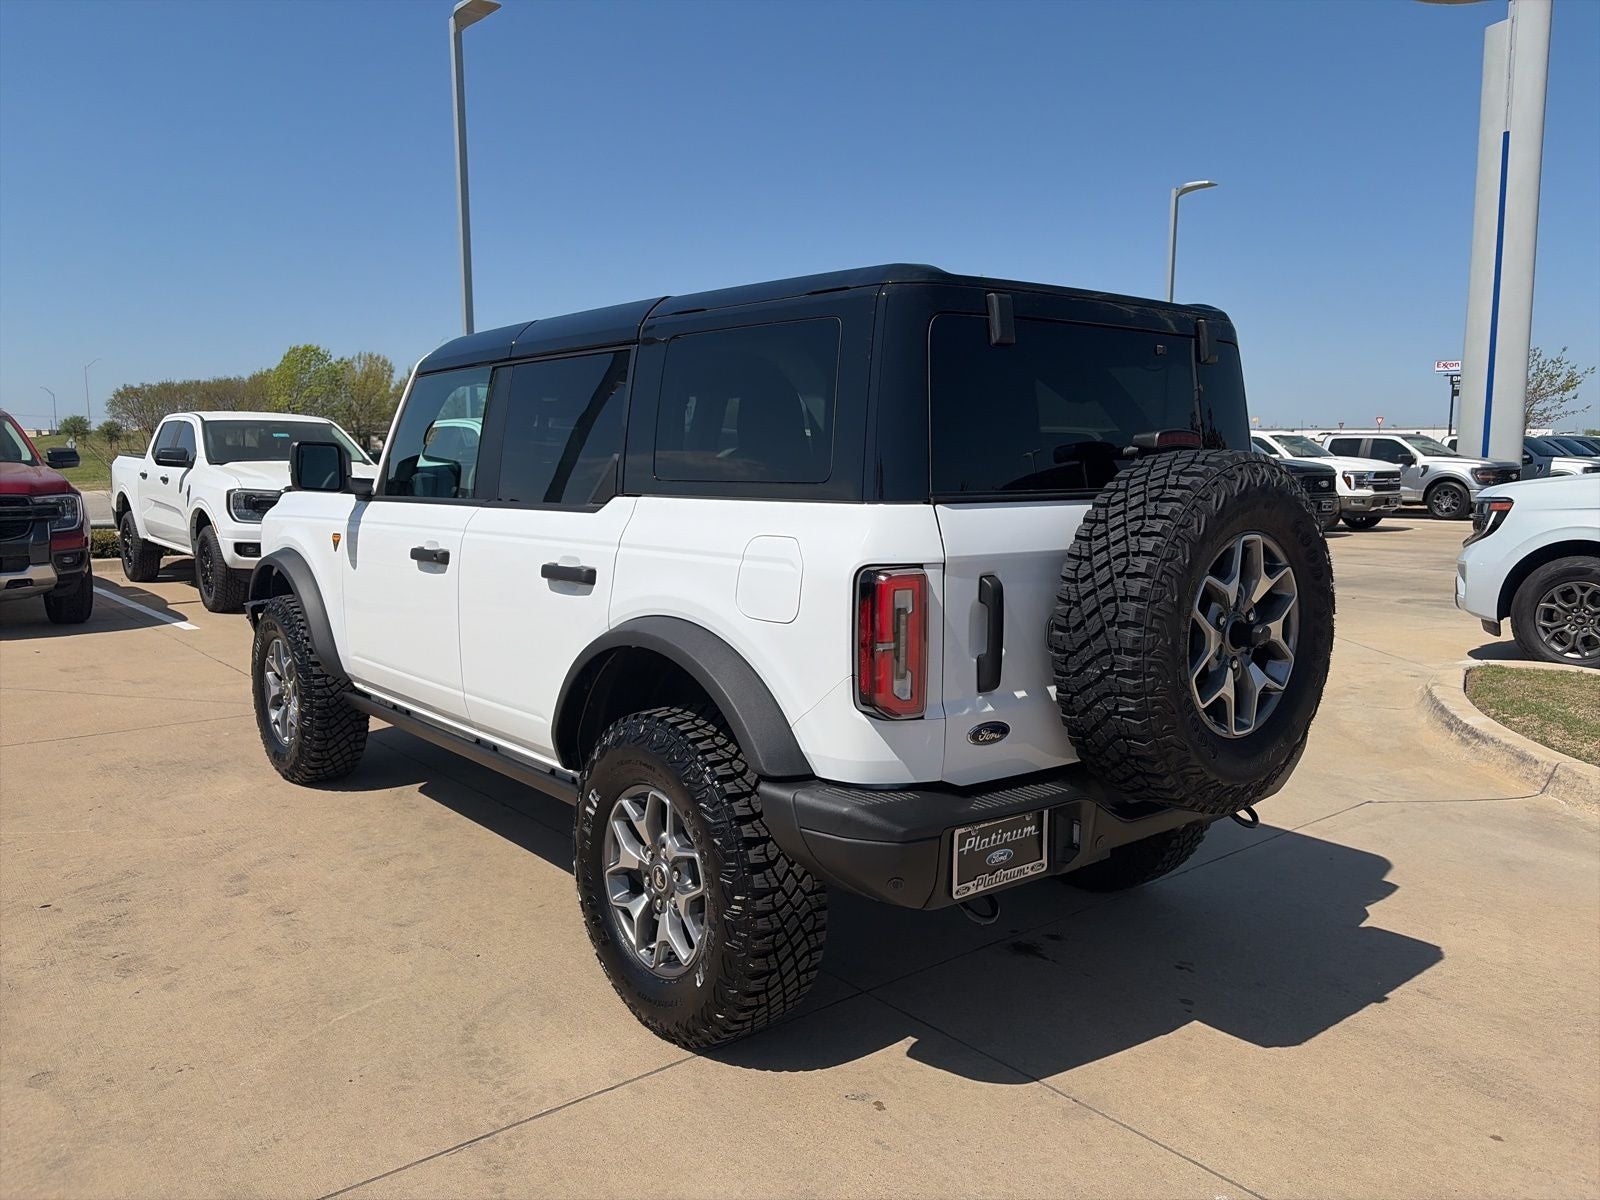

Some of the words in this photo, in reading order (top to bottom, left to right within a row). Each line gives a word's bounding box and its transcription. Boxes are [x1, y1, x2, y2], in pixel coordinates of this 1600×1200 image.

[1436, 361, 1459, 369] Exxon
[959, 825, 1039, 855] Platinum
[975, 867, 1028, 890] Platinum
